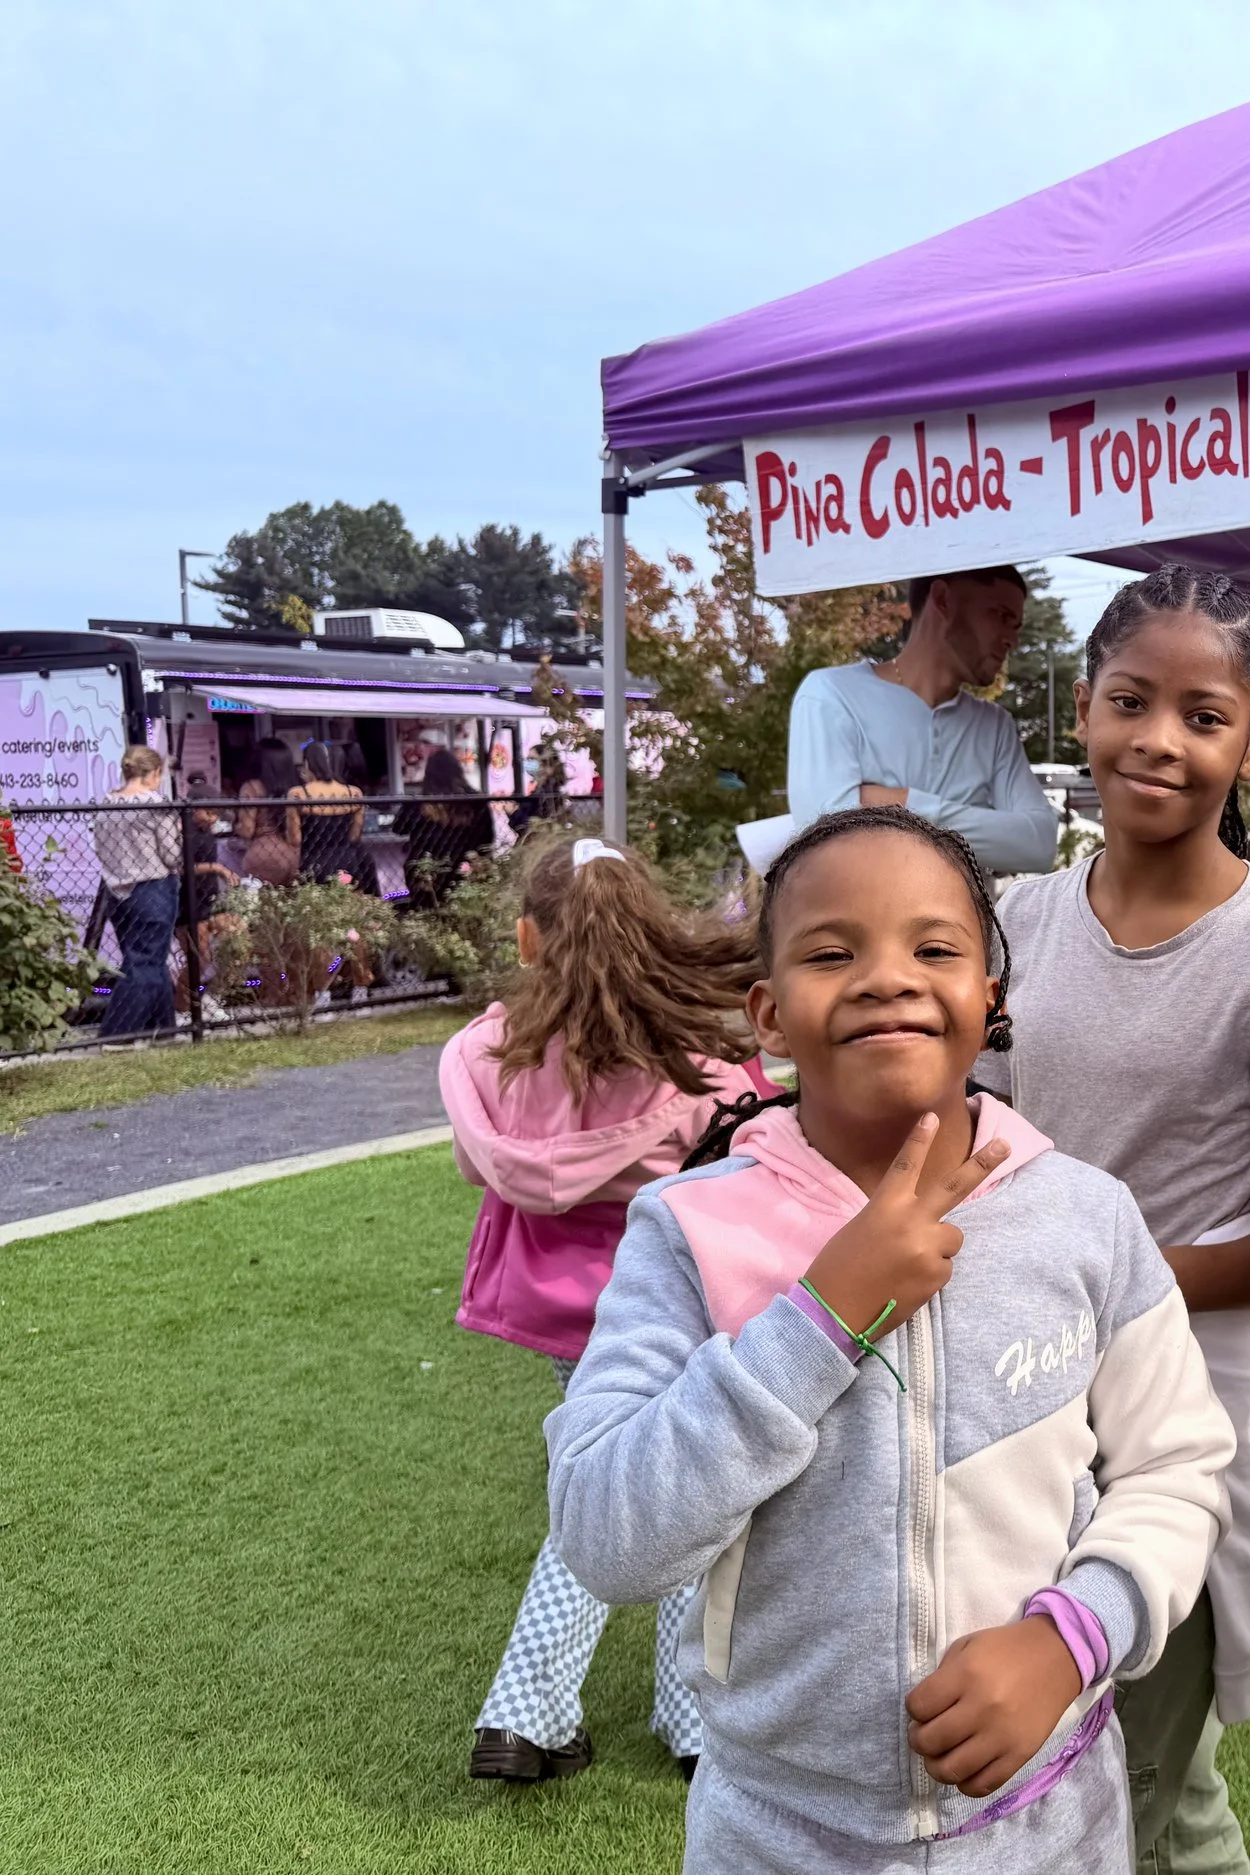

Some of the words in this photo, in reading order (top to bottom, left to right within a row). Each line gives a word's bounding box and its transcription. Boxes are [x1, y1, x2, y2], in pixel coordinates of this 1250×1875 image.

[859, 413, 1012, 540] Colada
[1049, 370, 1250, 527] Tropical
[2, 737, 100, 758] catering/events
